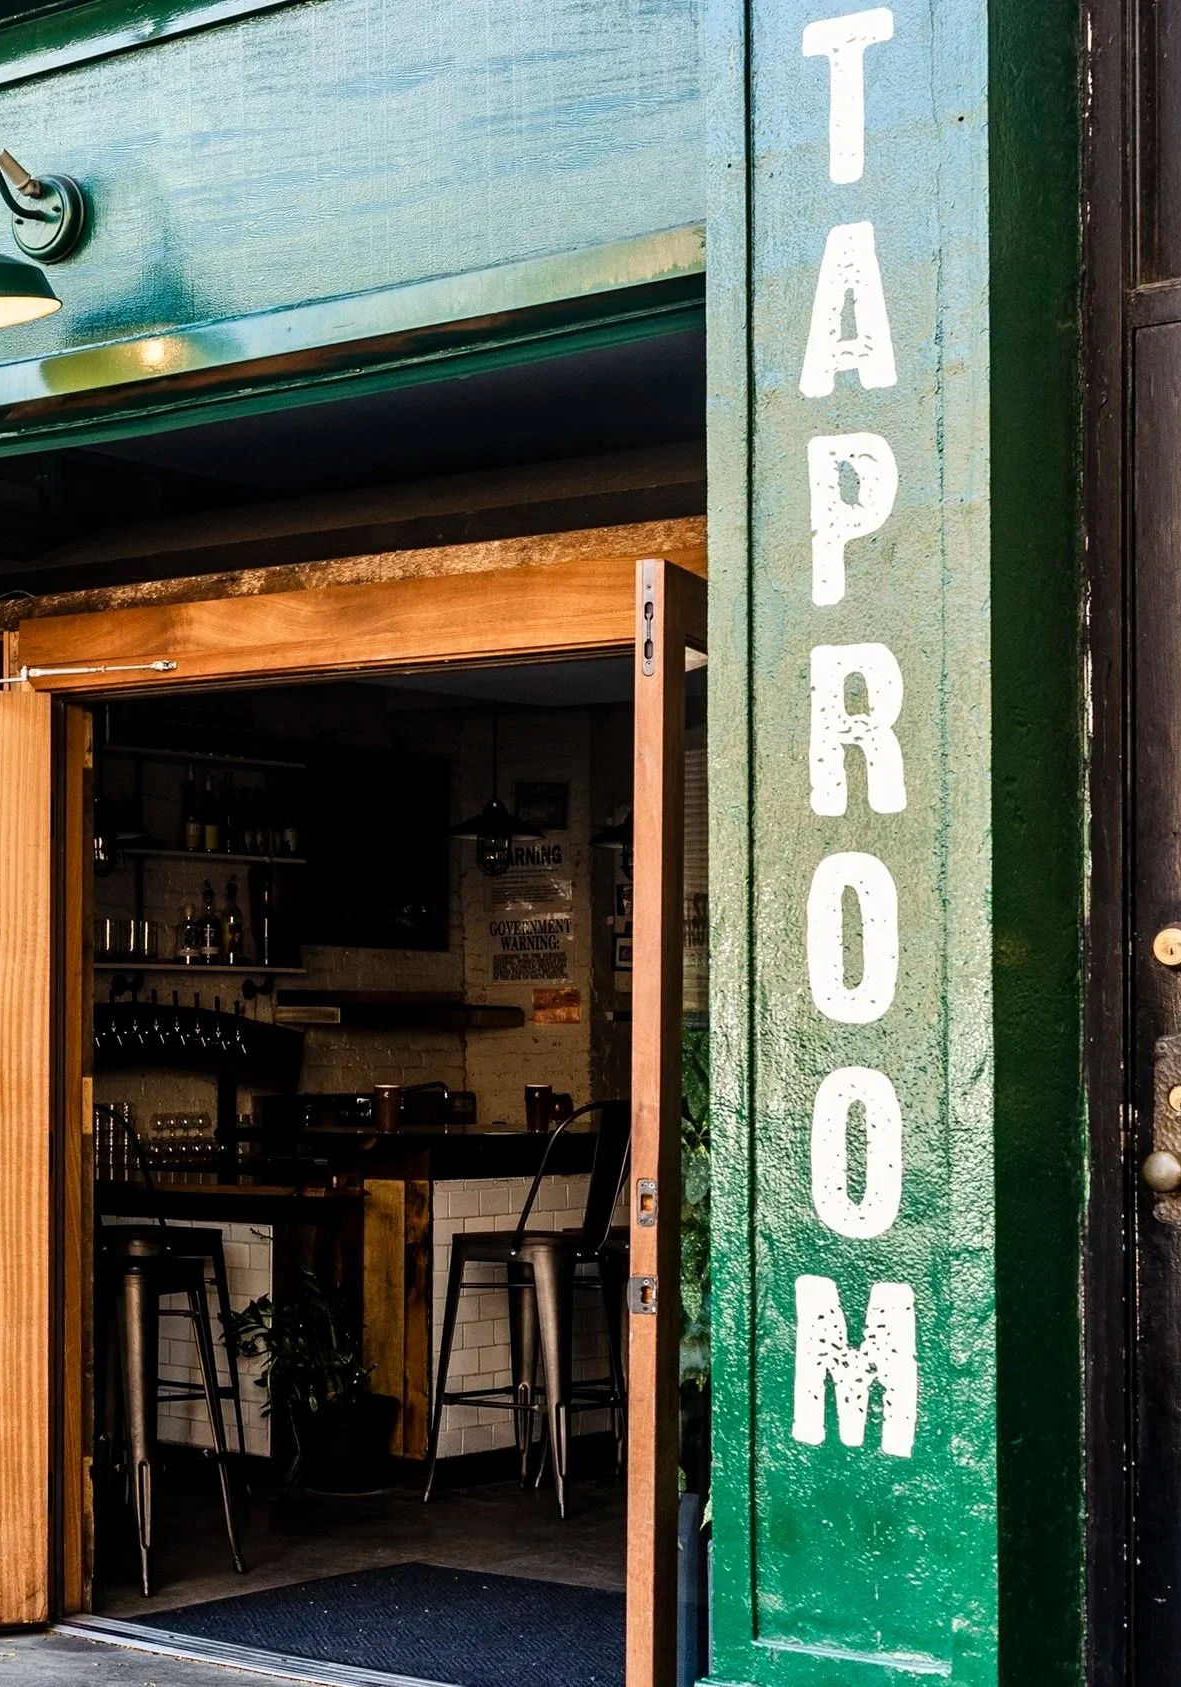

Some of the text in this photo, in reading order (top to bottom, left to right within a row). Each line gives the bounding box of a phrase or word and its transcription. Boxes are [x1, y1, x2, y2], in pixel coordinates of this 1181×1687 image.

[792, 6, 918, 1458] TAPROOM
[489, 918, 572, 937] GOVERNMENT
[501, 934, 560, 952] WARNING:
